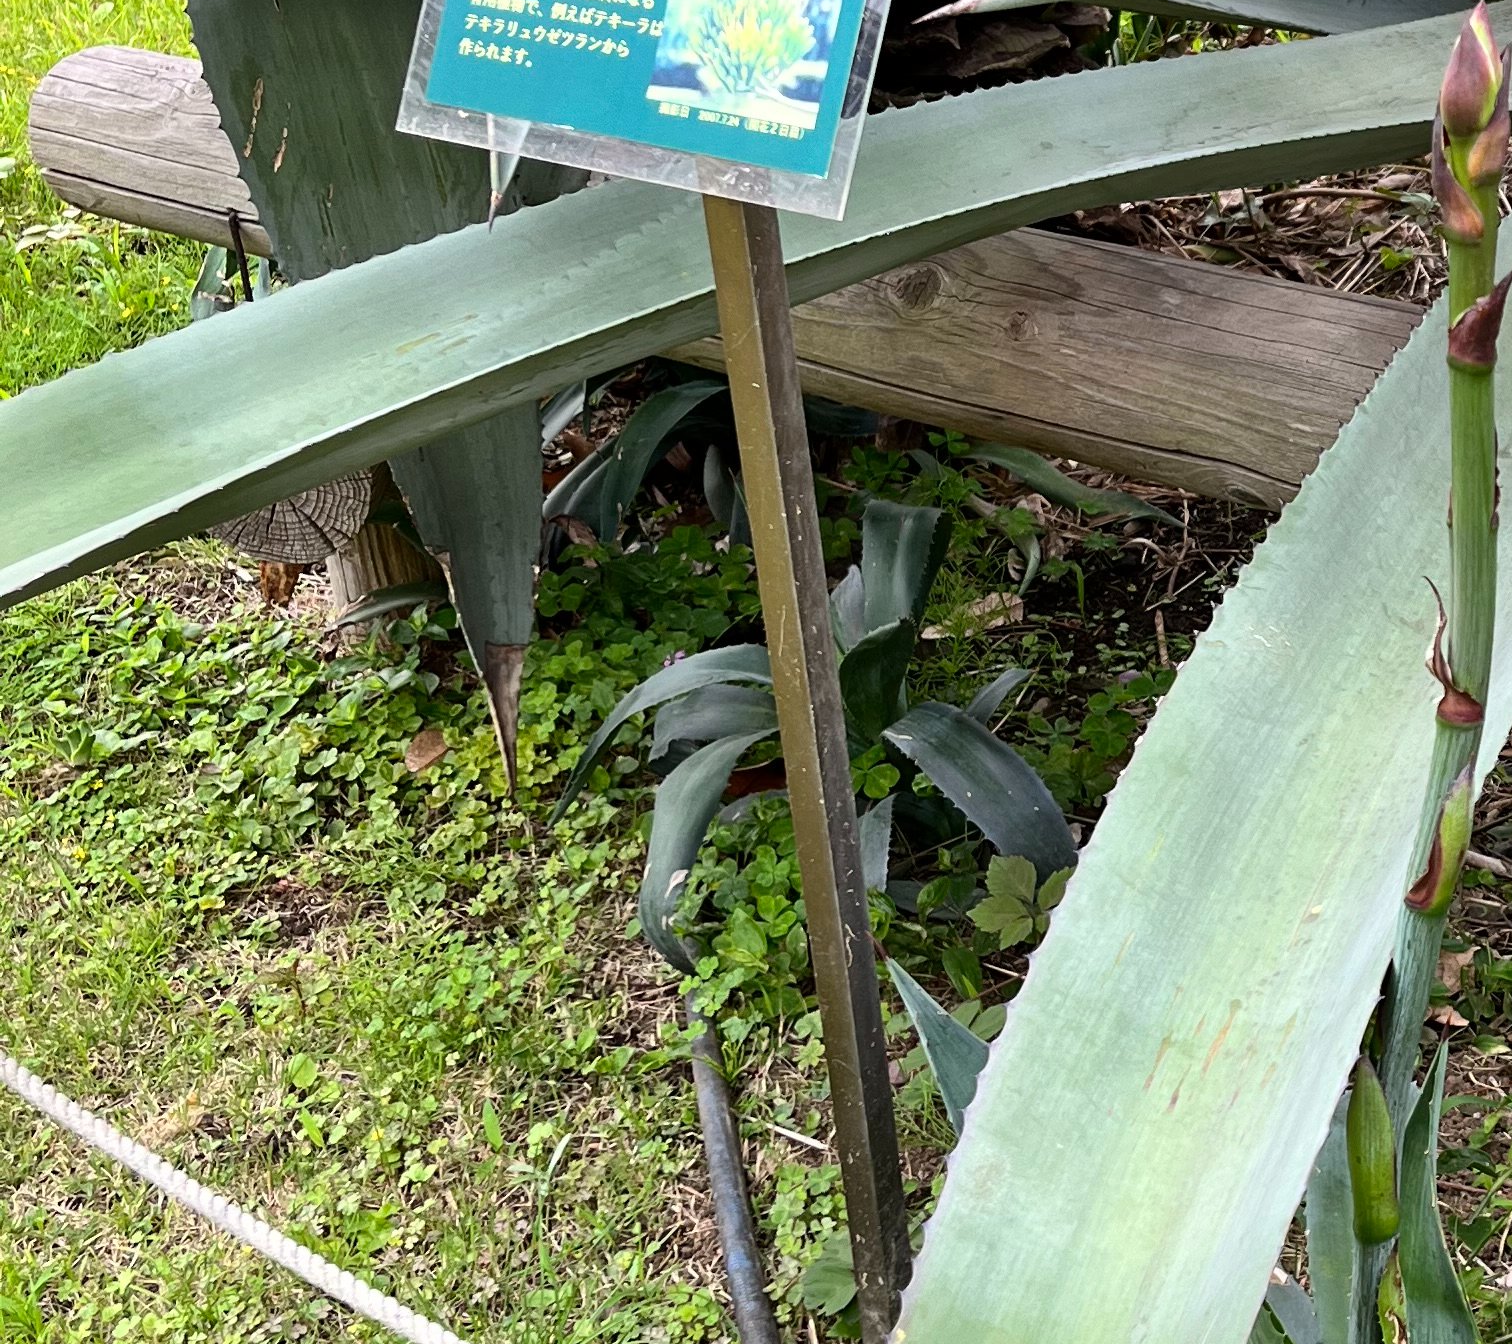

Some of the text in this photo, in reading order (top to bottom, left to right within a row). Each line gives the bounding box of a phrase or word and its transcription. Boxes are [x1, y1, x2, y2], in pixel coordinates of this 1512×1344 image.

[458, 38, 533, 68] 作られます。
[464, 14, 630, 58] テキラリュウゼツランから
